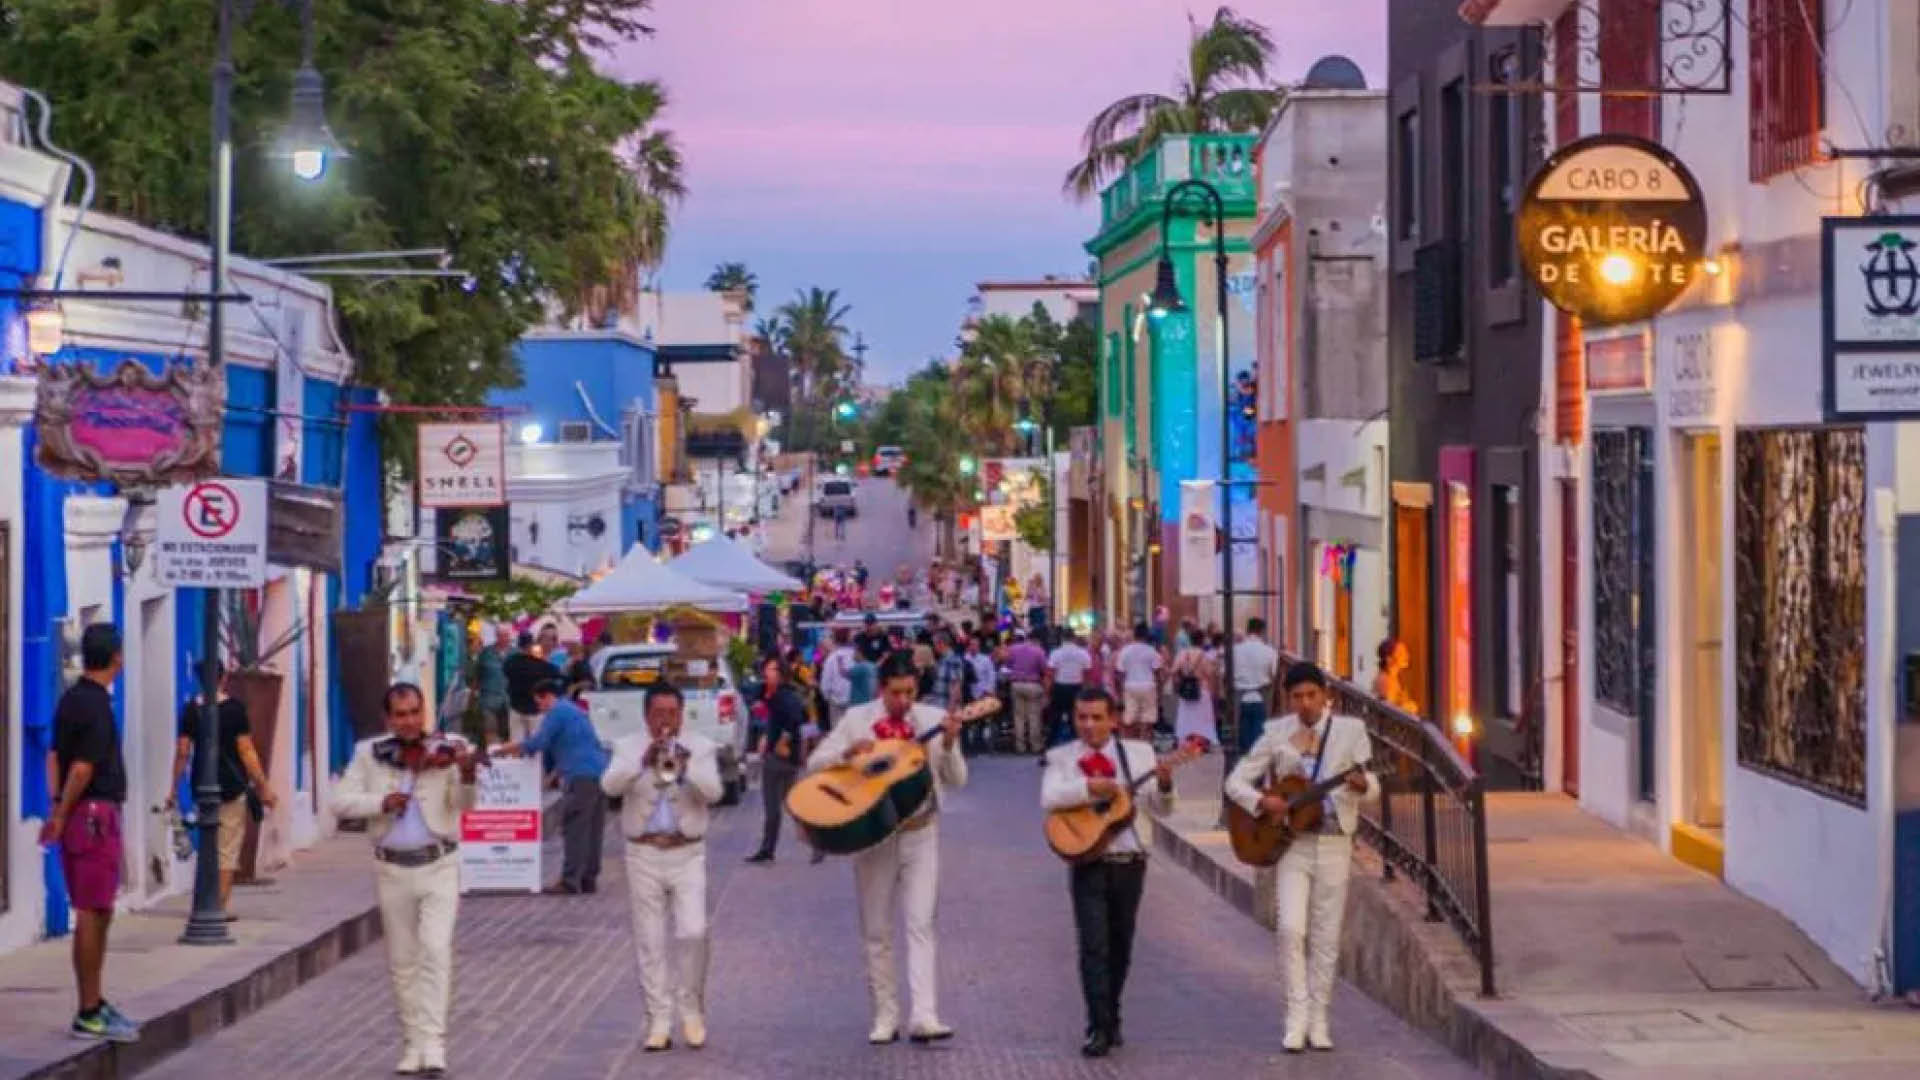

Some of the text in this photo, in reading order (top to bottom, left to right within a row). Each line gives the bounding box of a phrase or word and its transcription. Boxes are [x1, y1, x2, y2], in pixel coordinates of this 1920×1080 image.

[1566, 168, 1662, 191] CABO 8
[1540, 219, 1686, 254] GALERÍA
[1540, 263, 1580, 283] DE
